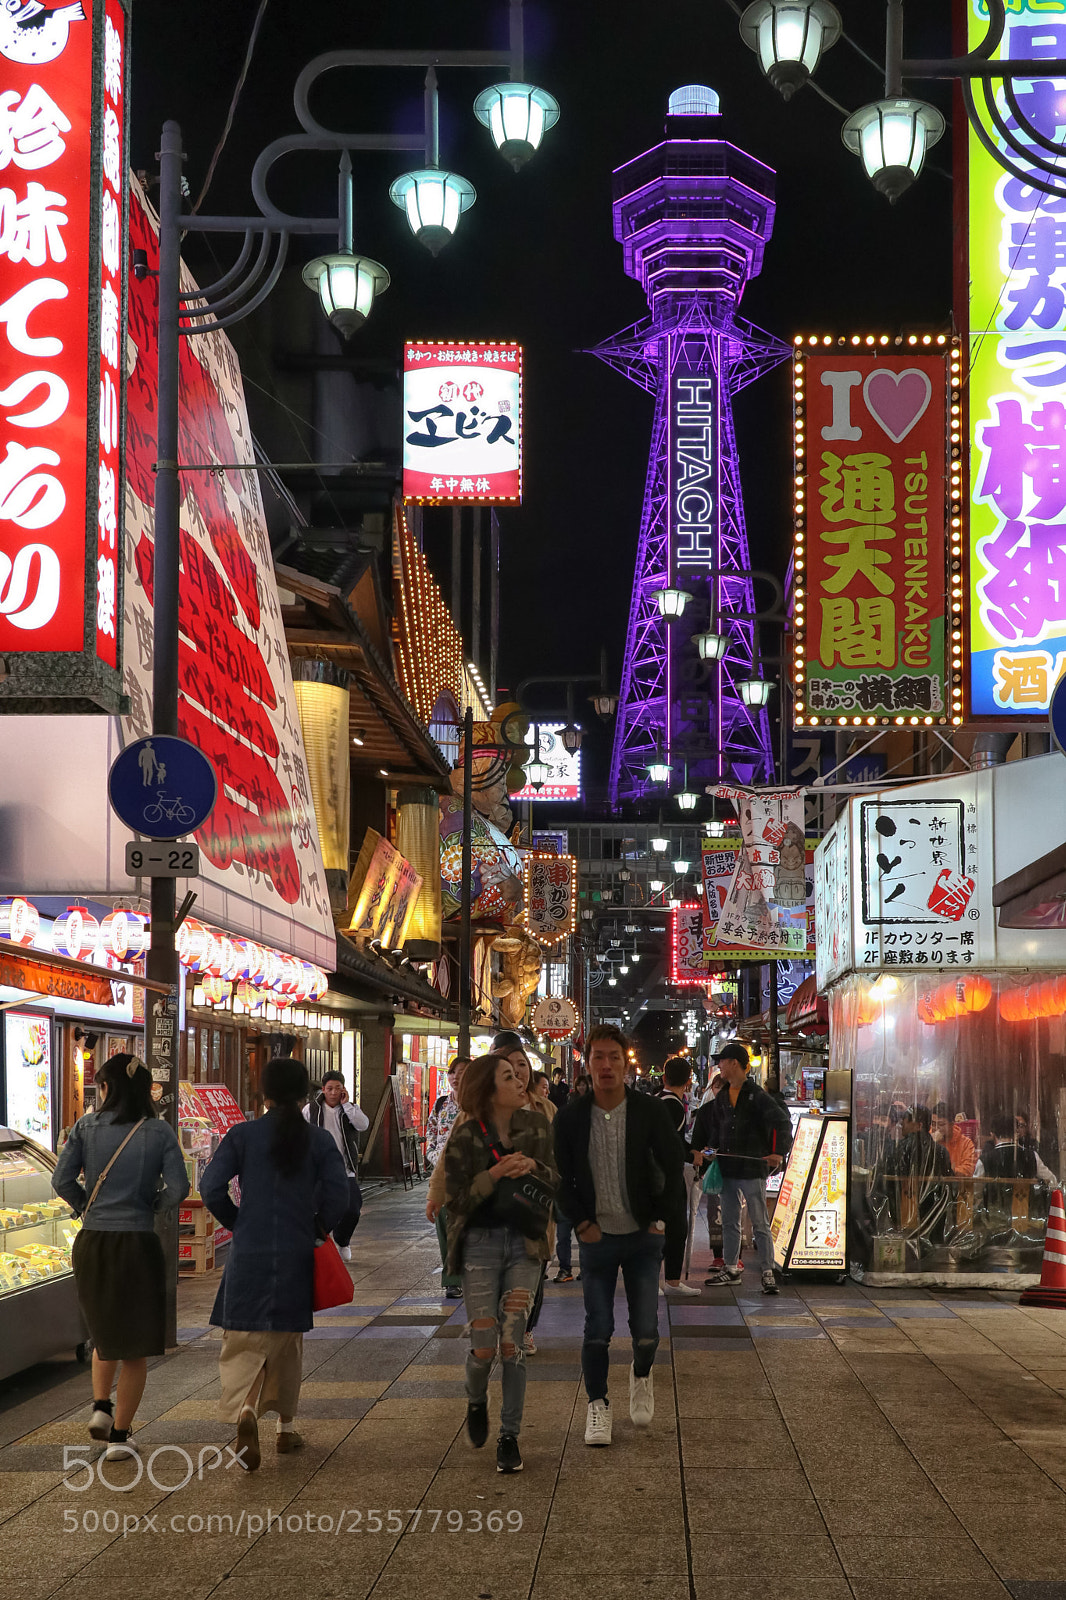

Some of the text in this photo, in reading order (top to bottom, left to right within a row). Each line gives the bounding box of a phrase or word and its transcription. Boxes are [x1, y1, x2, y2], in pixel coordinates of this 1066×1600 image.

[407, 349, 517, 362] 串かつ・お好み焼き・焼きそば
[439, 381, 485, 402] 初代
[820, 371, 860, 441] I
[406, 404, 516, 448] エビス
[430, 477, 491, 493] 年中無休
[677, 379, 712, 570] HITACHI
[819, 451, 897, 666] 通天閣
[904, 452, 929, 665] TSUTENKAKU
[810, 680, 853, 692] 日本一の
[810, 694, 854, 708] 串かつ
[928, 816, 952, 866] 新世界
[966, 803, 979, 875] 商標登録
[704, 852, 735, 866] 新世界
[547, 863, 569, 920] 串かつ
[865, 931, 975, 946] 1F カウンター席
[865, 950, 975, 965] 2F 座敷あります
